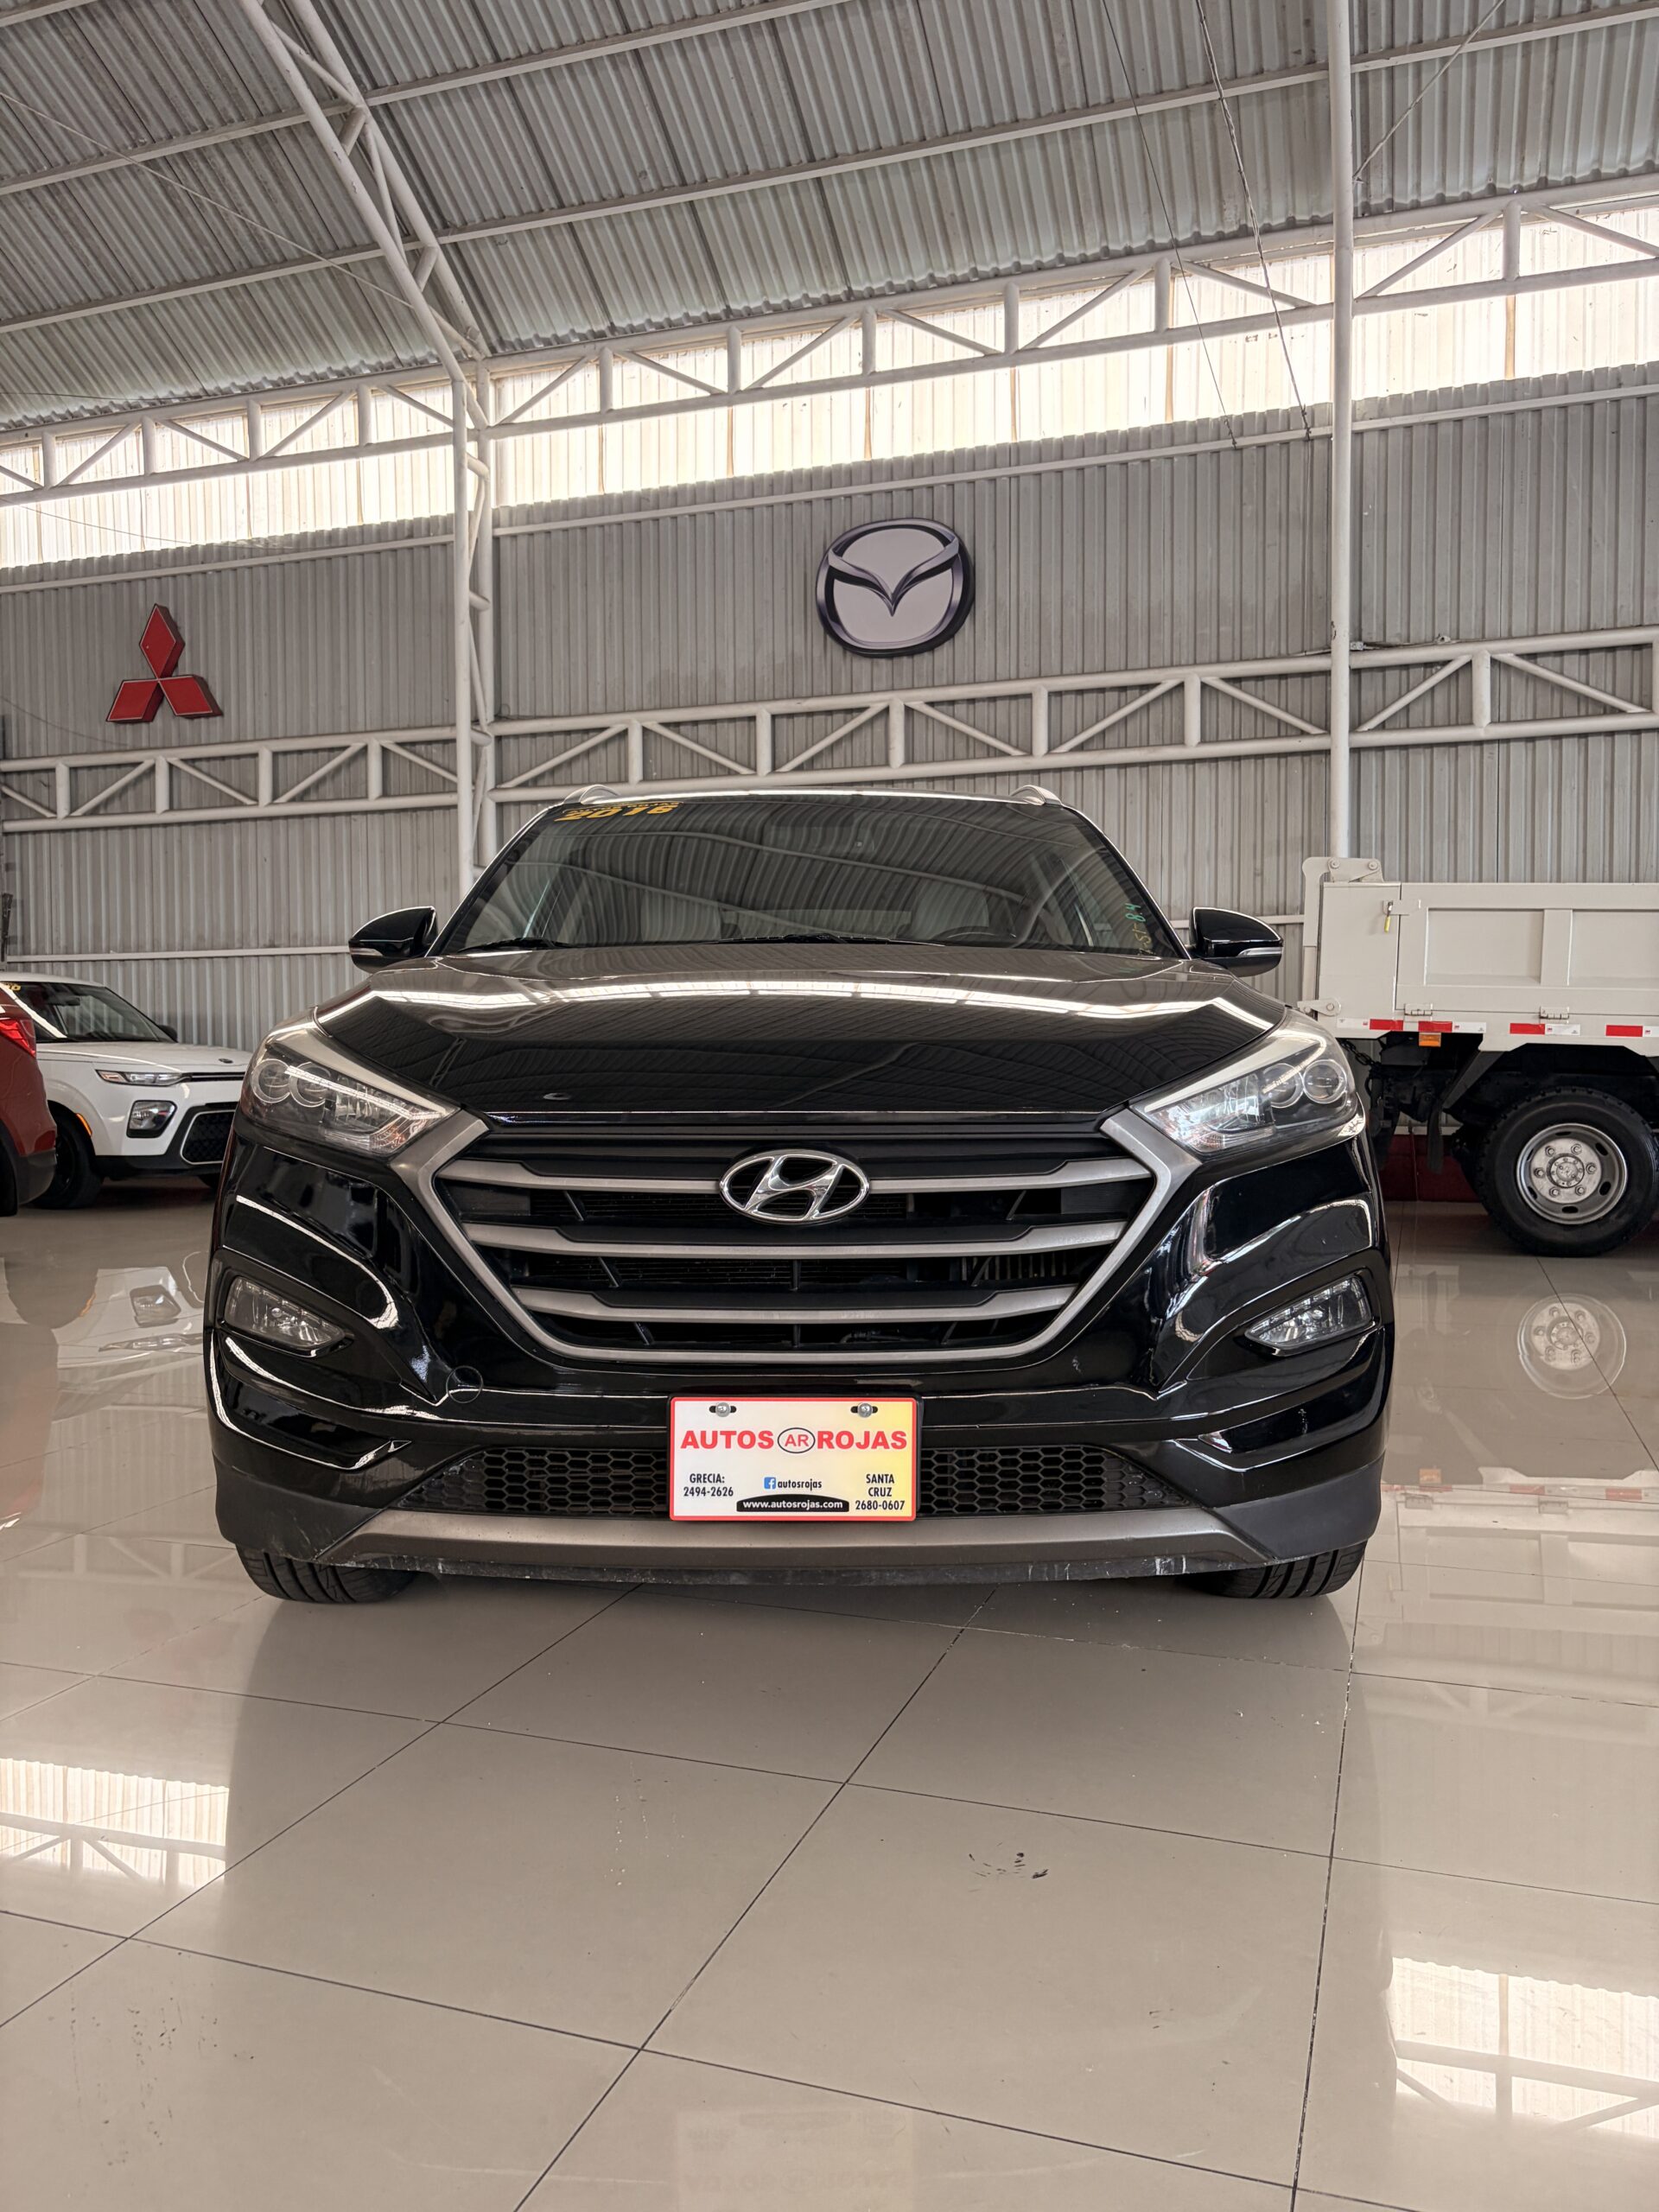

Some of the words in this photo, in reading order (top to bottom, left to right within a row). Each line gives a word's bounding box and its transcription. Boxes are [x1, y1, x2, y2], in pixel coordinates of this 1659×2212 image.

[680, 1430, 774, 1450] AUTOS
[784, 1433, 810, 1447] AR
[817, 1430, 907, 1450] ROJAS
[689, 1473, 725, 1484] GRECIA:
[866, 1474, 895, 1484] SANTA
[777, 1478, 823, 1491] autosrojas
[683, 1486, 734, 1497] 2494-2626
[868, 1487, 893, 1497] CRUZ
[742, 1500, 843, 1510] www.autosrojas.com
[855, 1500, 906, 1511] 2680-0607
